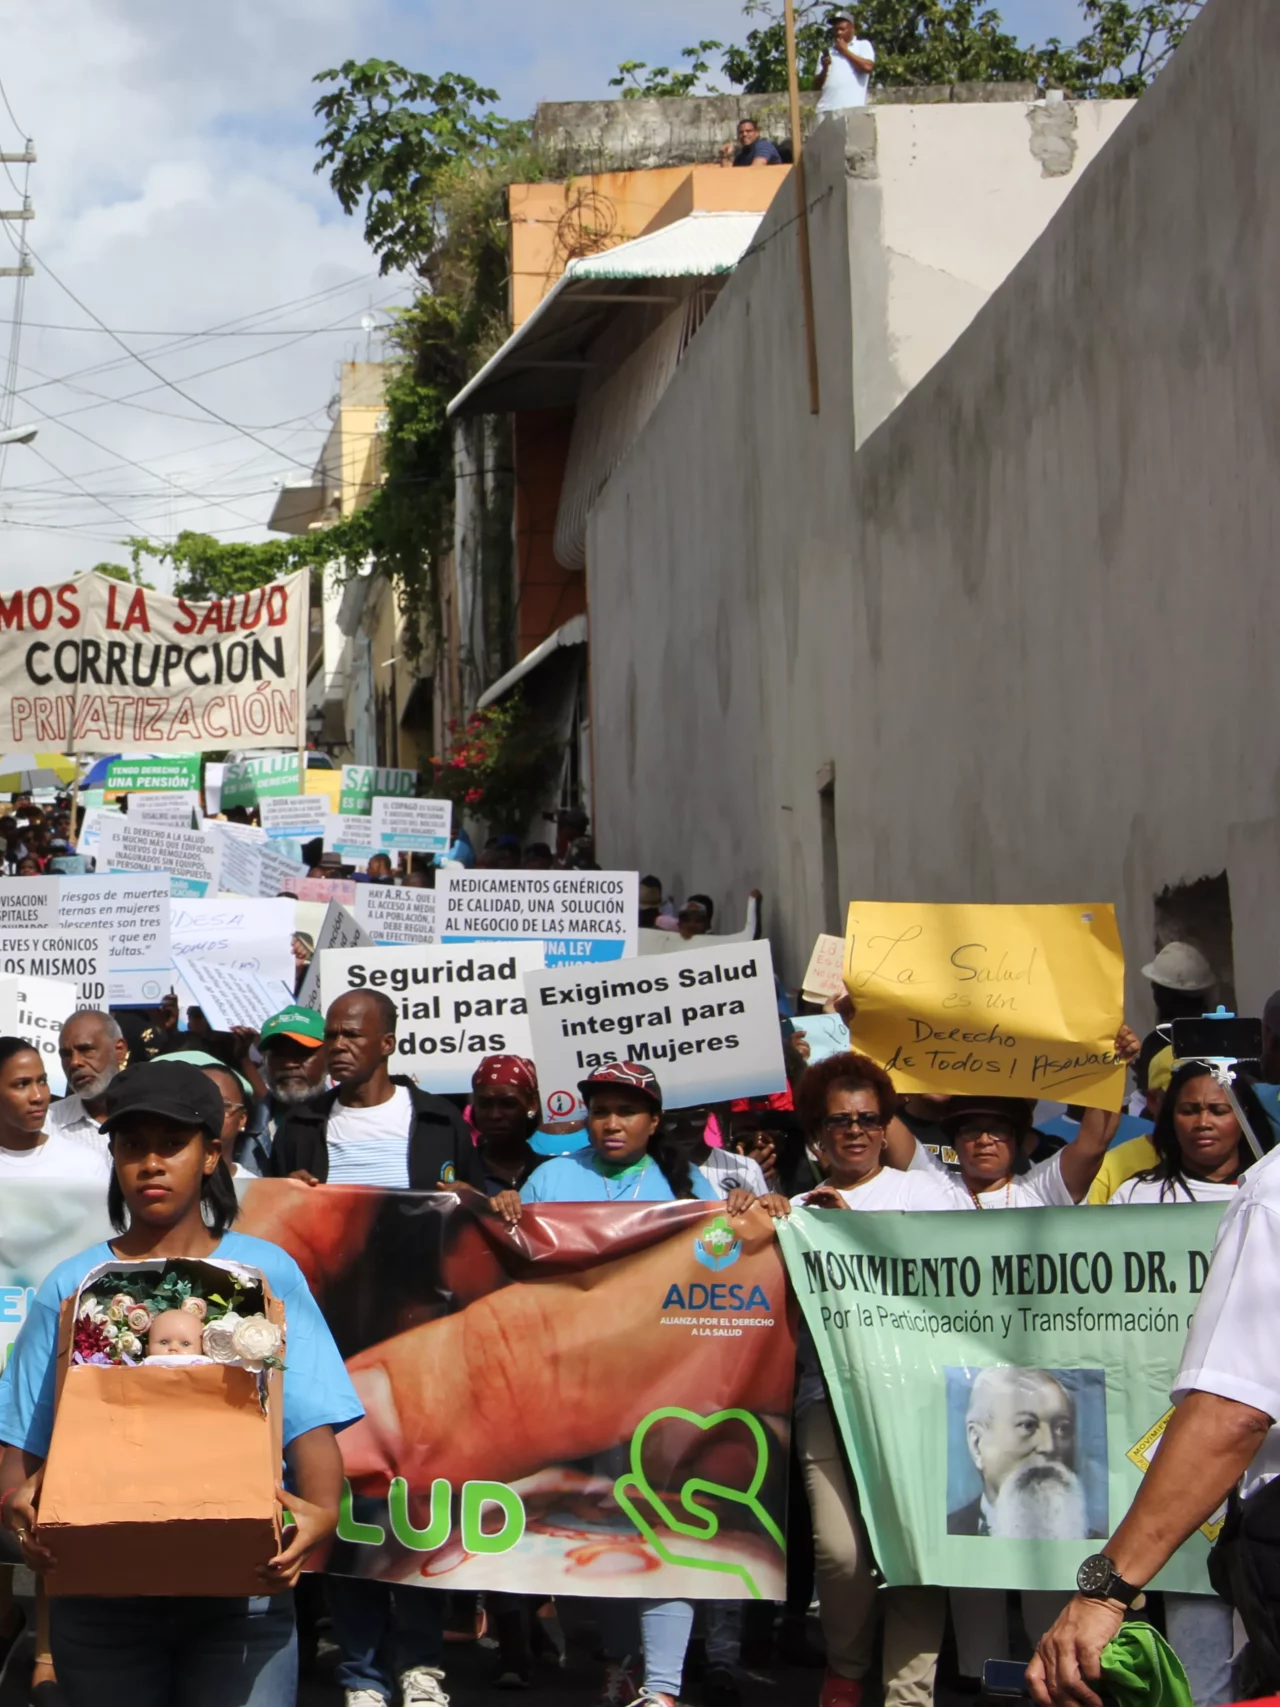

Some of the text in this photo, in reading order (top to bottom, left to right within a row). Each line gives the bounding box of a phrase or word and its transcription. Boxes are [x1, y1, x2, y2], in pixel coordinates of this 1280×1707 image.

[106, 585, 150, 632] LA
[174, 585, 288, 634] SALUD
[26, 632, 285, 687] CORRUPCIÓN
[12, 681, 296, 741] PRIVATIZACIÓN
[108, 775, 189, 787] UNA PENSIÓN
[134, 828, 165, 839] DERECHO
[449, 877, 623, 894] MEDICAMENTOS GENÉRICOS
[62, 890, 168, 903] riesgos de muertes
[448, 895, 624, 914] DE CALIDAD, UNA SOLUCIÓN
[116, 904, 160, 915] mujeres
[378, 901, 405, 911] ACCESO
[140, 919, 160, 927] tres
[445, 918, 460, 931] AL
[464, 918, 520, 932] NEGOCIO
[523, 919, 539, 932] DE
[542, 918, 564, 934] LA$
[32, 939, 39, 950] Y
[42, 936, 98, 952] CRÓNICOS
[119, 933, 156, 943] que en
[570, 942, 592, 956] LEY
[30, 958, 97, 976] MISMOS
[951, 943, 1036, 985] Salud
[348, 957, 517, 991] Seguridad
[540, 960, 758, 1006] Exigimos Salud
[454, 996, 528, 1023] para
[942, 992, 971, 1009] es
[561, 999, 745, 1037] integral para
[398, 1030, 506, 1056] dos/as
[576, 1034, 740, 1068] las Mujeres
[802, 1250, 1177, 1297] MOVIMIENTO MEDICO DR.
[662, 1284, 771, 1311] ADESA
[699, 1318, 718, 1326] POR
[720, 1318, 730, 1326] EL
[732, 1318, 775, 1326] DERECHO
[821, 1304, 1179, 1338] Por la Participación y Transformación
